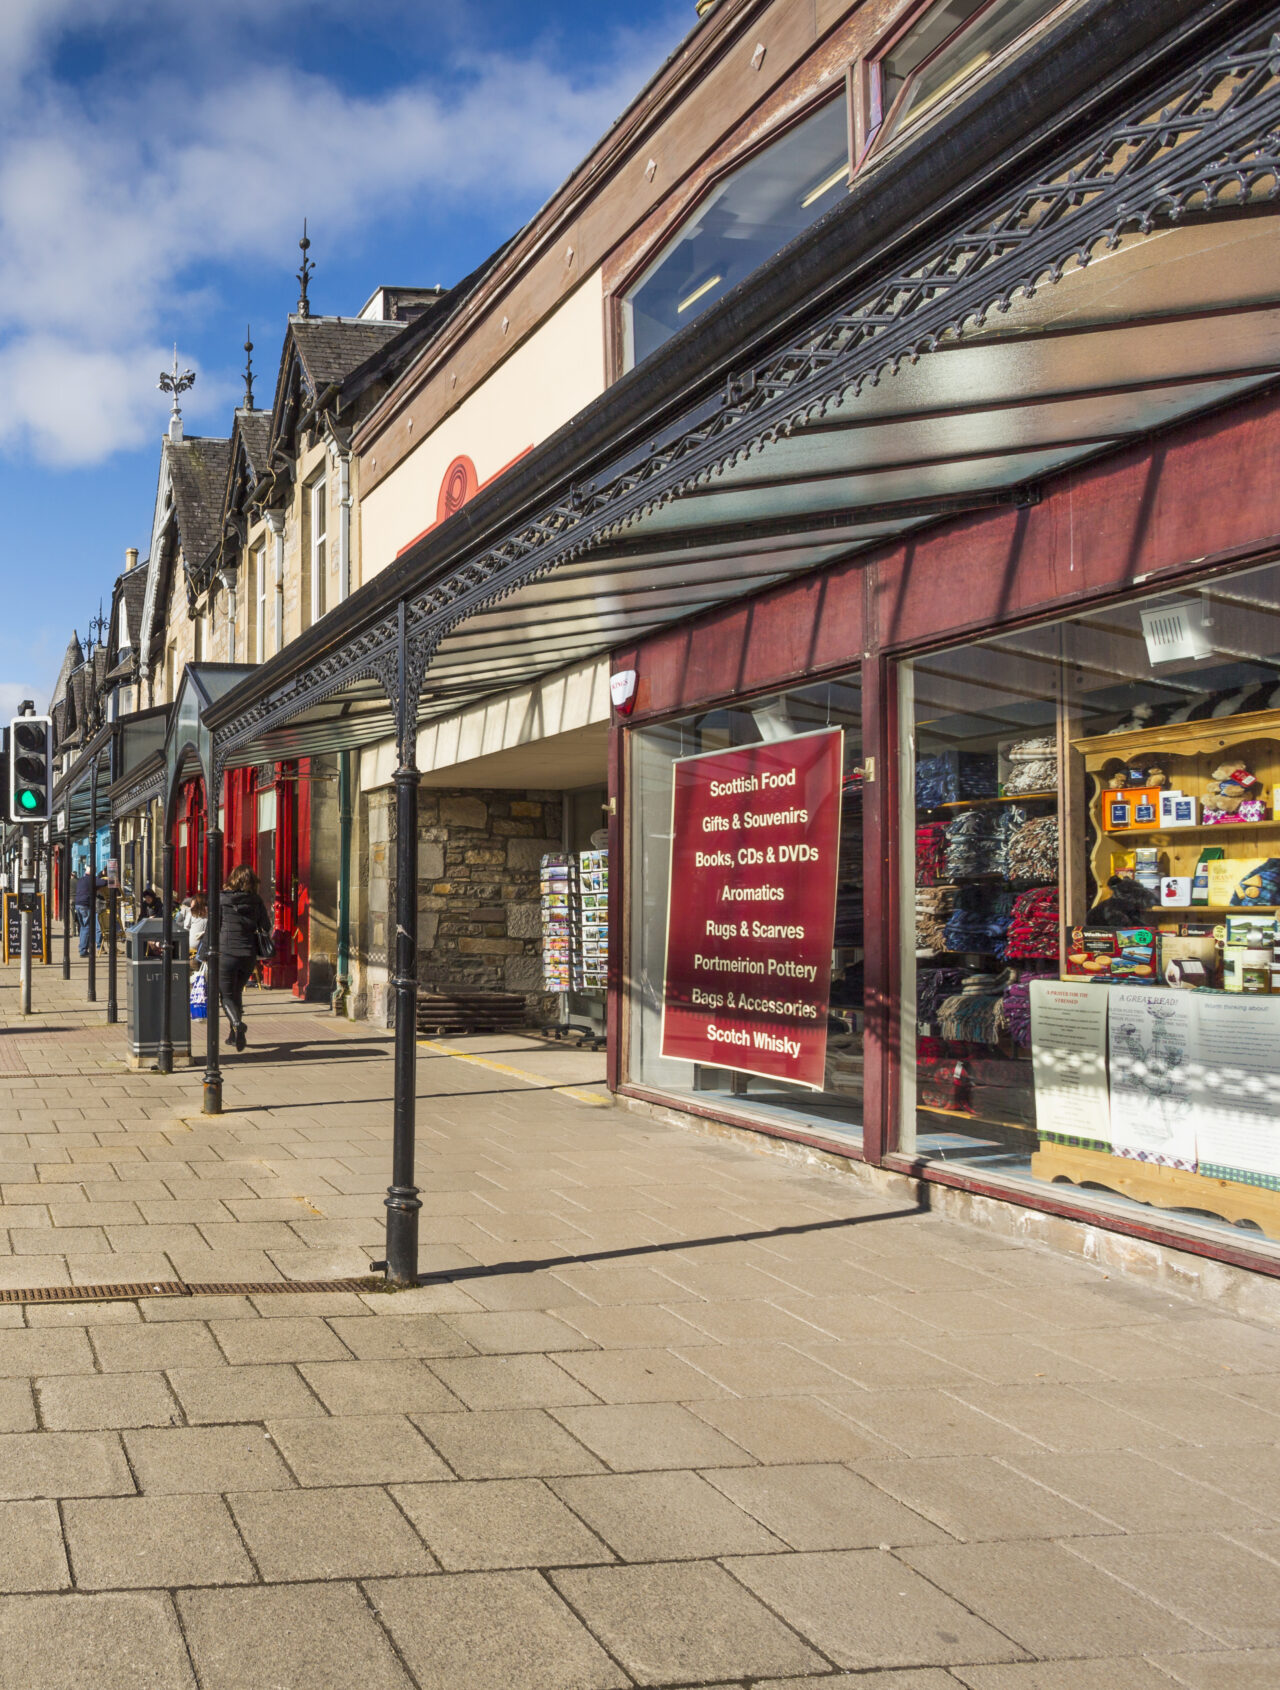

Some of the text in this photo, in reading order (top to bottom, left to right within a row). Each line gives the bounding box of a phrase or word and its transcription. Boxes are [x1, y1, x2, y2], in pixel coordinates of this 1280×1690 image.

[710, 768, 796, 797] Scottish Food
[702, 807, 808, 832] Gifts & Souvenirs
[696, 844, 819, 868] Books, CDs & DVDs
[721, 884, 785, 903] Aromatics
[706, 920, 804, 940] Rugs & Scarves
[146, 973, 179, 981] LITR
[694, 954, 817, 982] Portmeirion Pottery
[692, 988, 817, 1018] Bags & Accessories
[707, 1024, 801, 1058] Scotch Whisky
